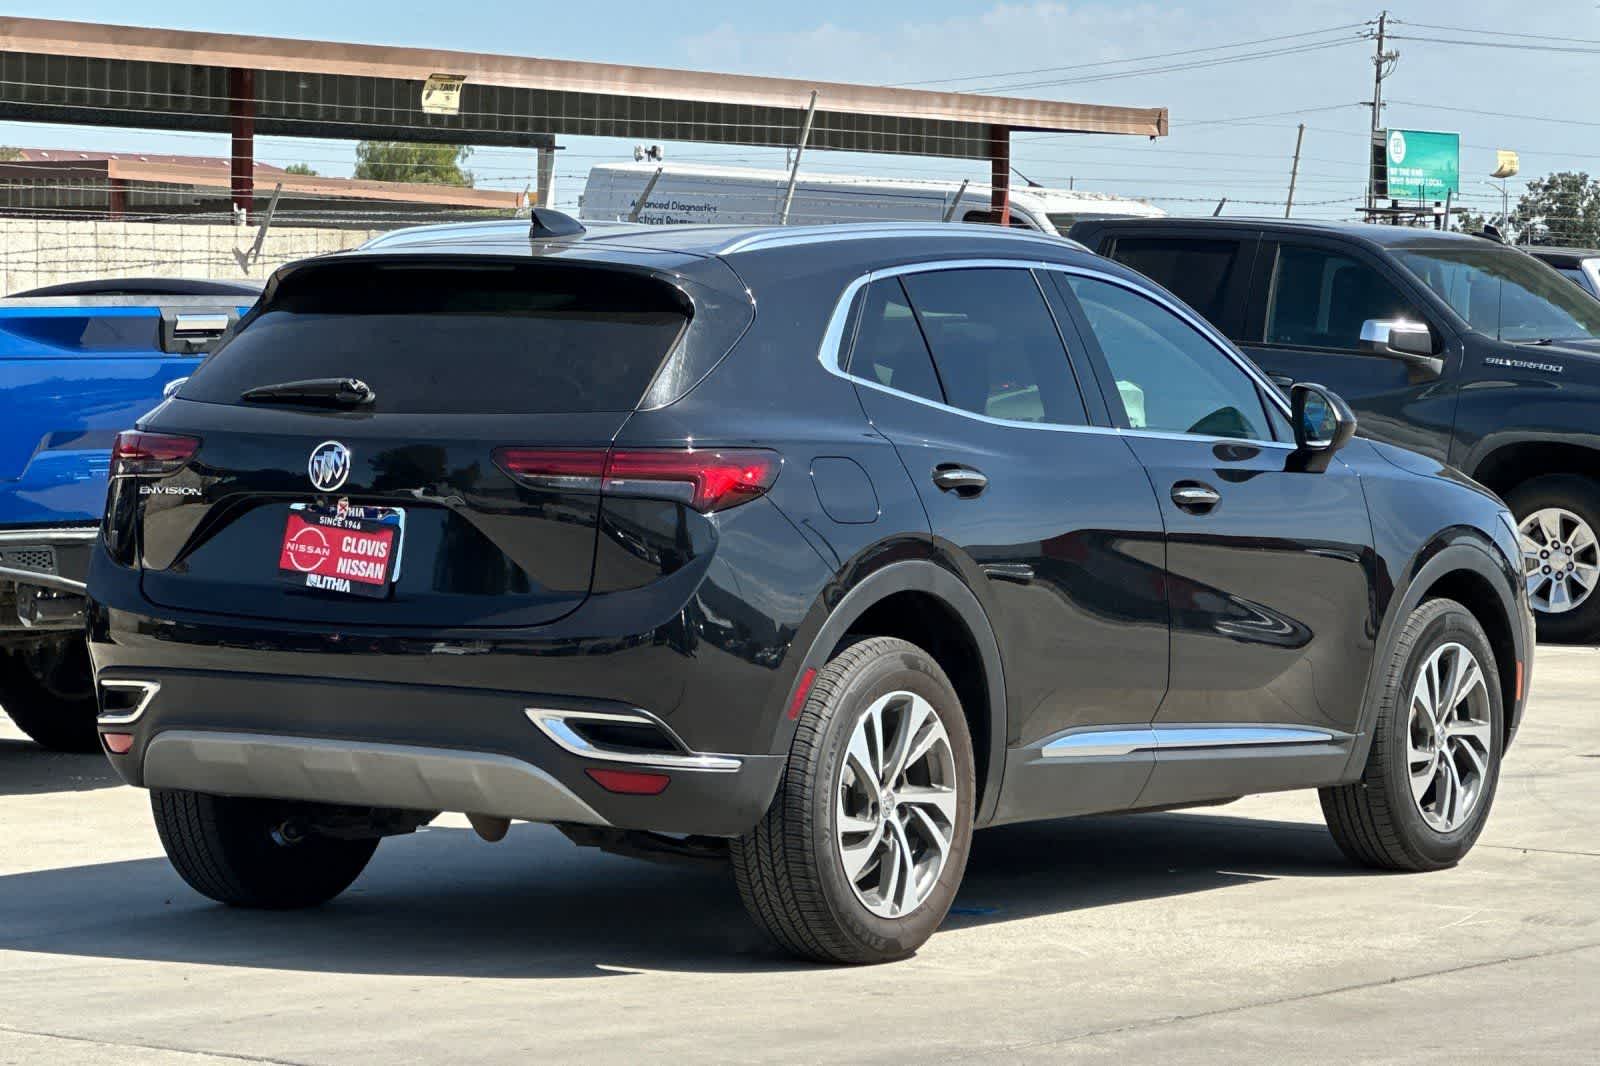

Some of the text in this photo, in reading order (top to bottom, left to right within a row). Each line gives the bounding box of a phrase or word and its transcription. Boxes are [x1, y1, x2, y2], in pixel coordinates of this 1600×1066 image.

[630, 200, 717, 212] Aanced Diagnostics
[1485, 357, 1563, 373] SILVERADO
[139, 486, 202, 496] ENVISION
[319, 516, 361, 530] SINCE 1946
[286, 541, 330, 556] NISSAN
[341, 536, 388, 558] CLOVIS
[336, 557, 385, 580] NISSAN
[317, 575, 351, 593] LITHIA
